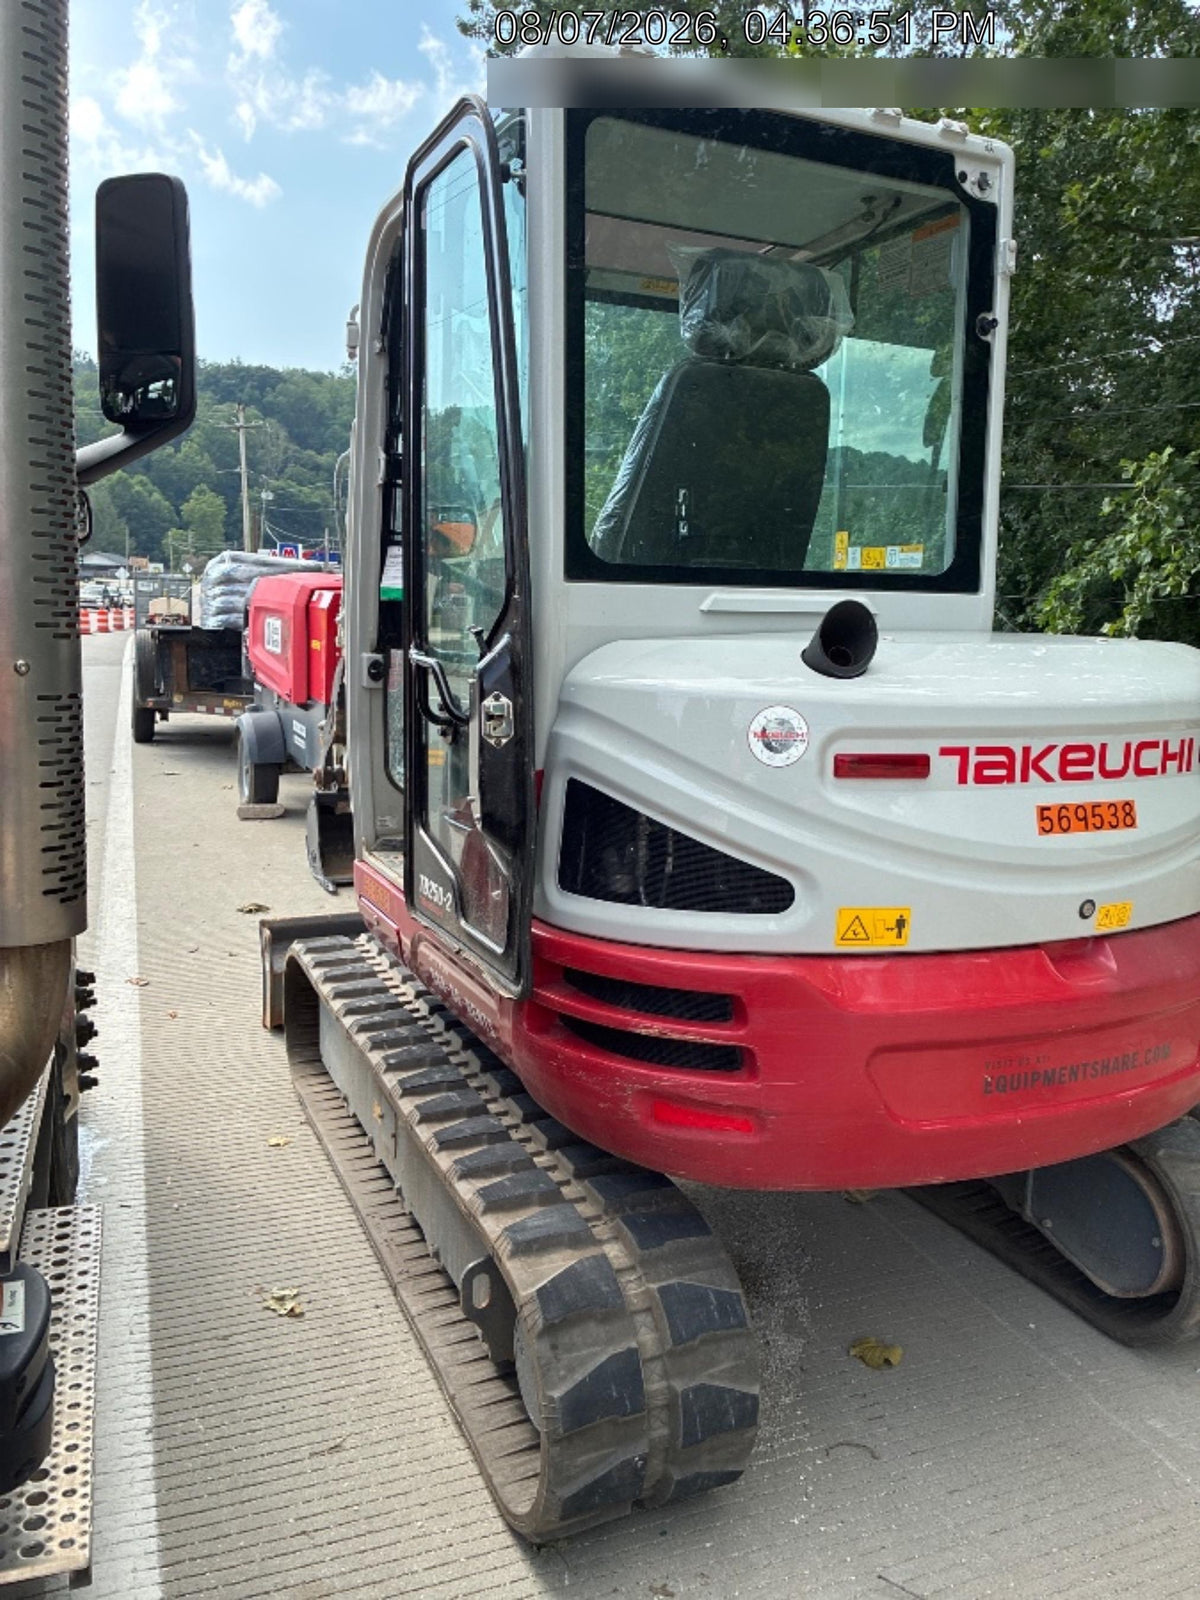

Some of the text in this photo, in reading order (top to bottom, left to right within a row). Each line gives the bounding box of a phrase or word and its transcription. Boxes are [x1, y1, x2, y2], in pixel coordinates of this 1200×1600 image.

[939, 737, 1194, 785] TAKEUCHI
[1038, 801, 1136, 834] 569538
[983, 1044, 1170, 1094] EQUIPMENTSHARE.COM
